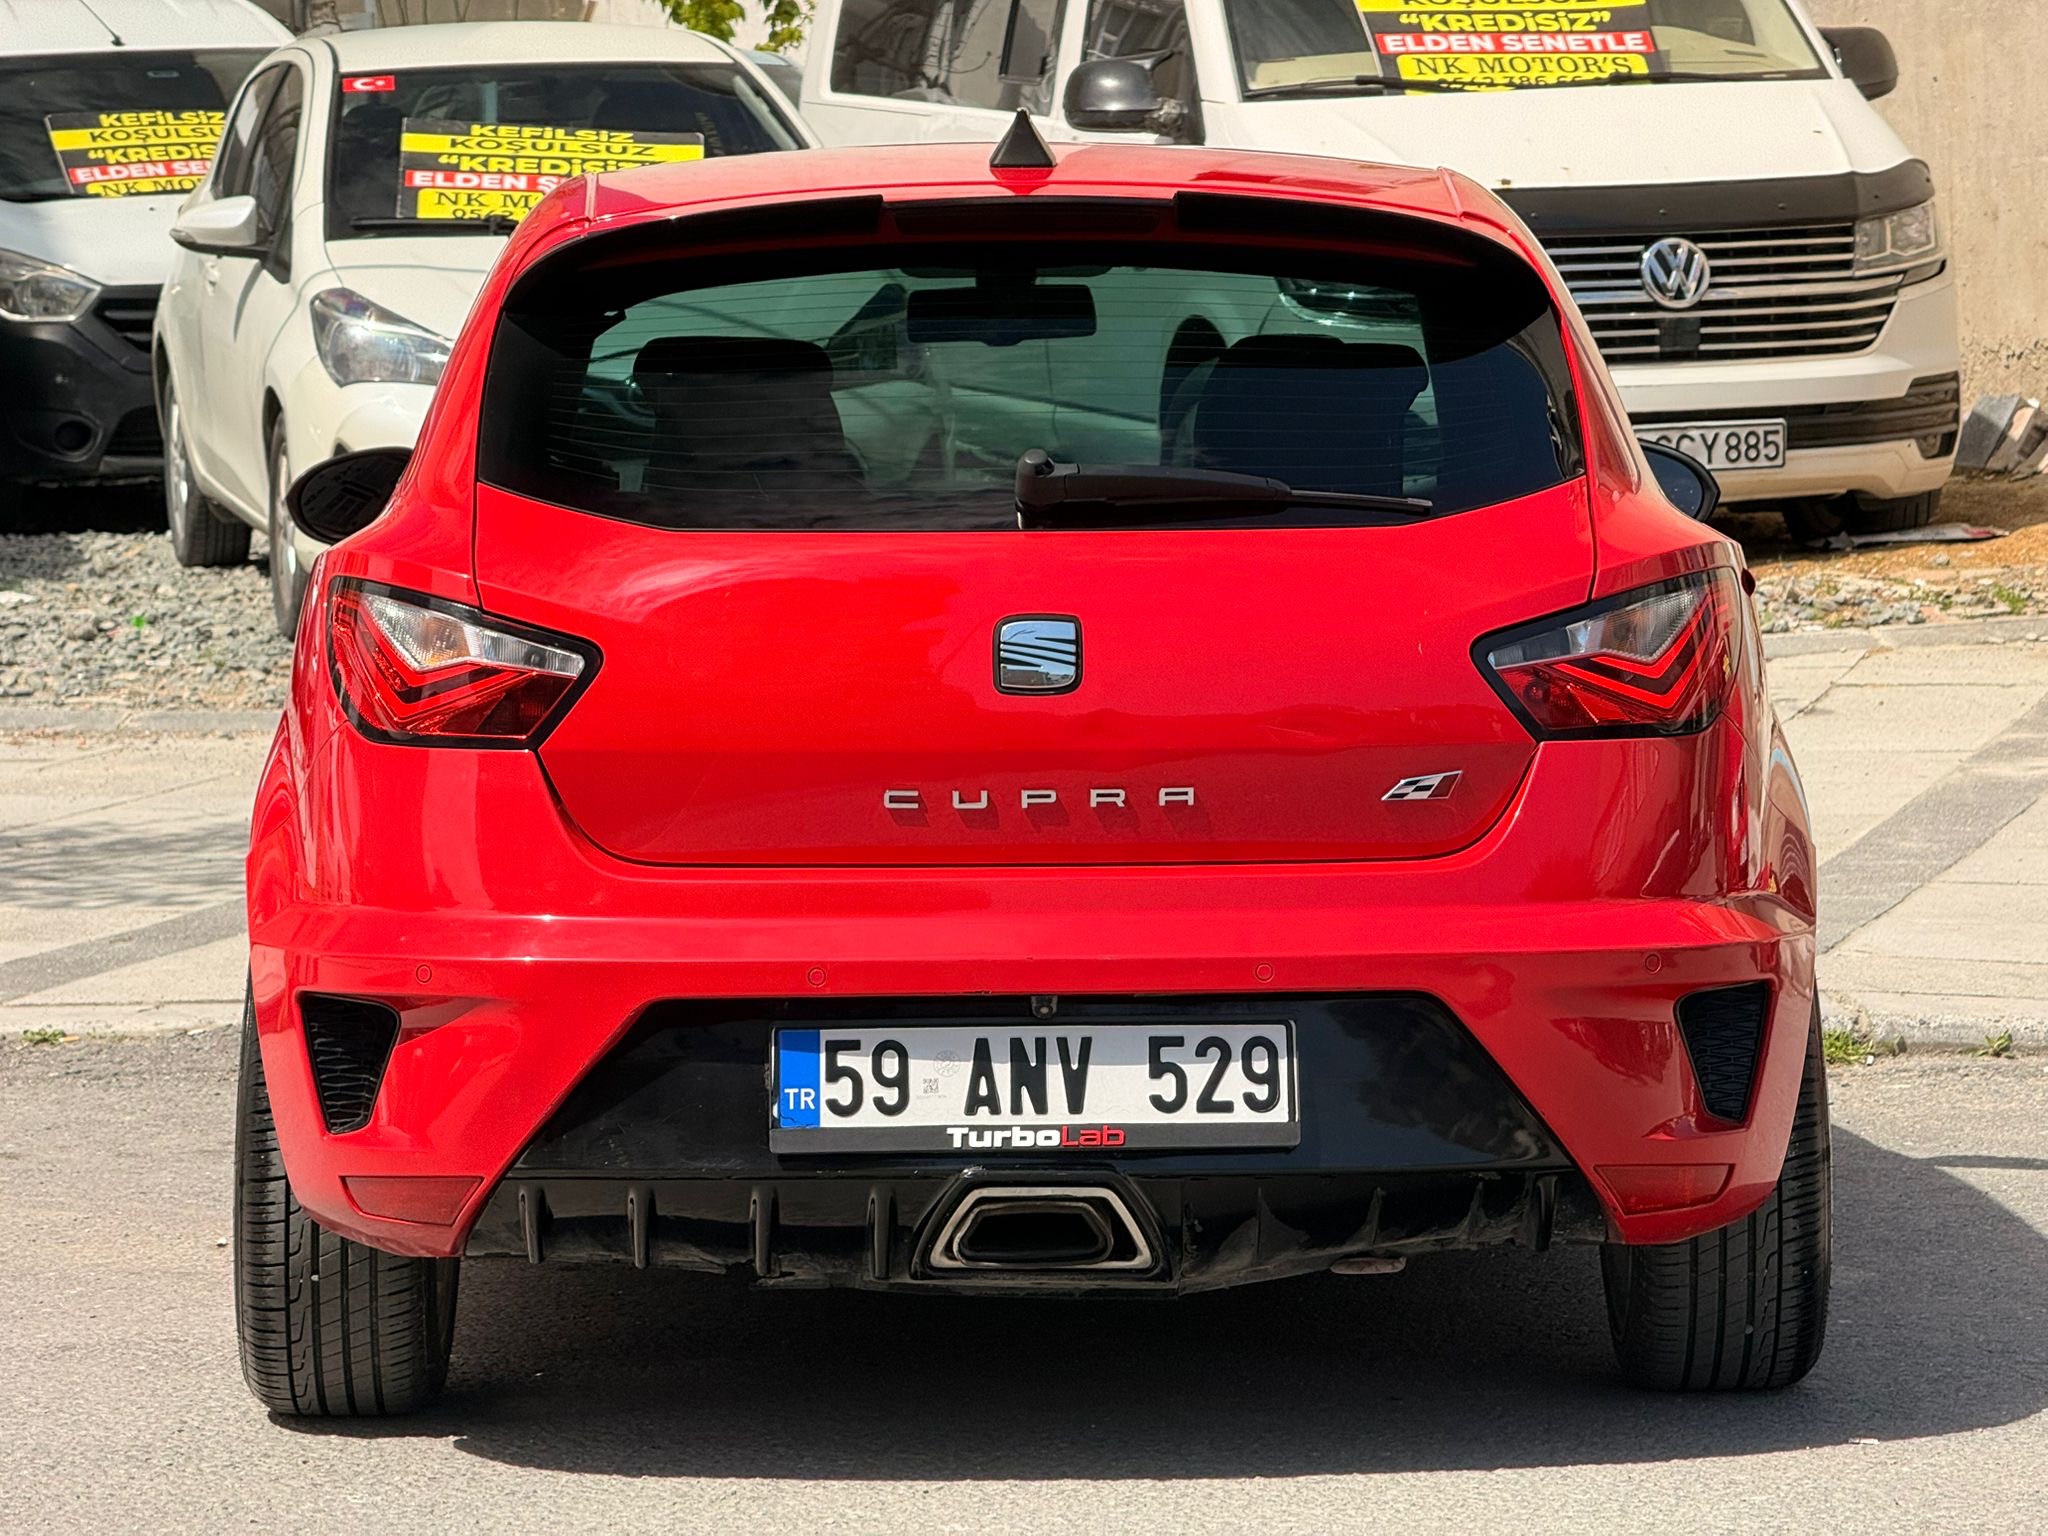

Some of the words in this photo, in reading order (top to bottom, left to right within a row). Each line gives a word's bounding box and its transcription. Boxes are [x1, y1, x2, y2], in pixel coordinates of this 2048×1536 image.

[1383, 35, 1496, 52] ELDEN
[1500, 33, 1649, 52] SENETLE
[1413, 57, 1467, 75] NK
[449, 137, 655, 155] KOŞULSUZ
[74, 162, 168, 182] ELDEN
[413, 171, 527, 190] ELDEN
[101, 181, 141, 196] NK
[434, 192, 489, 207] NK
[1643, 238, 1709, 308] VW
[882, 786, 1196, 810] CUPRA
[824, 1038, 911, 1117] 59
[964, 1036, 1093, 1116] ANV
[1147, 1035, 1281, 1114] 529
[784, 1087, 816, 1110] TR
[946, 1124, 1126, 1148] TurboLab
